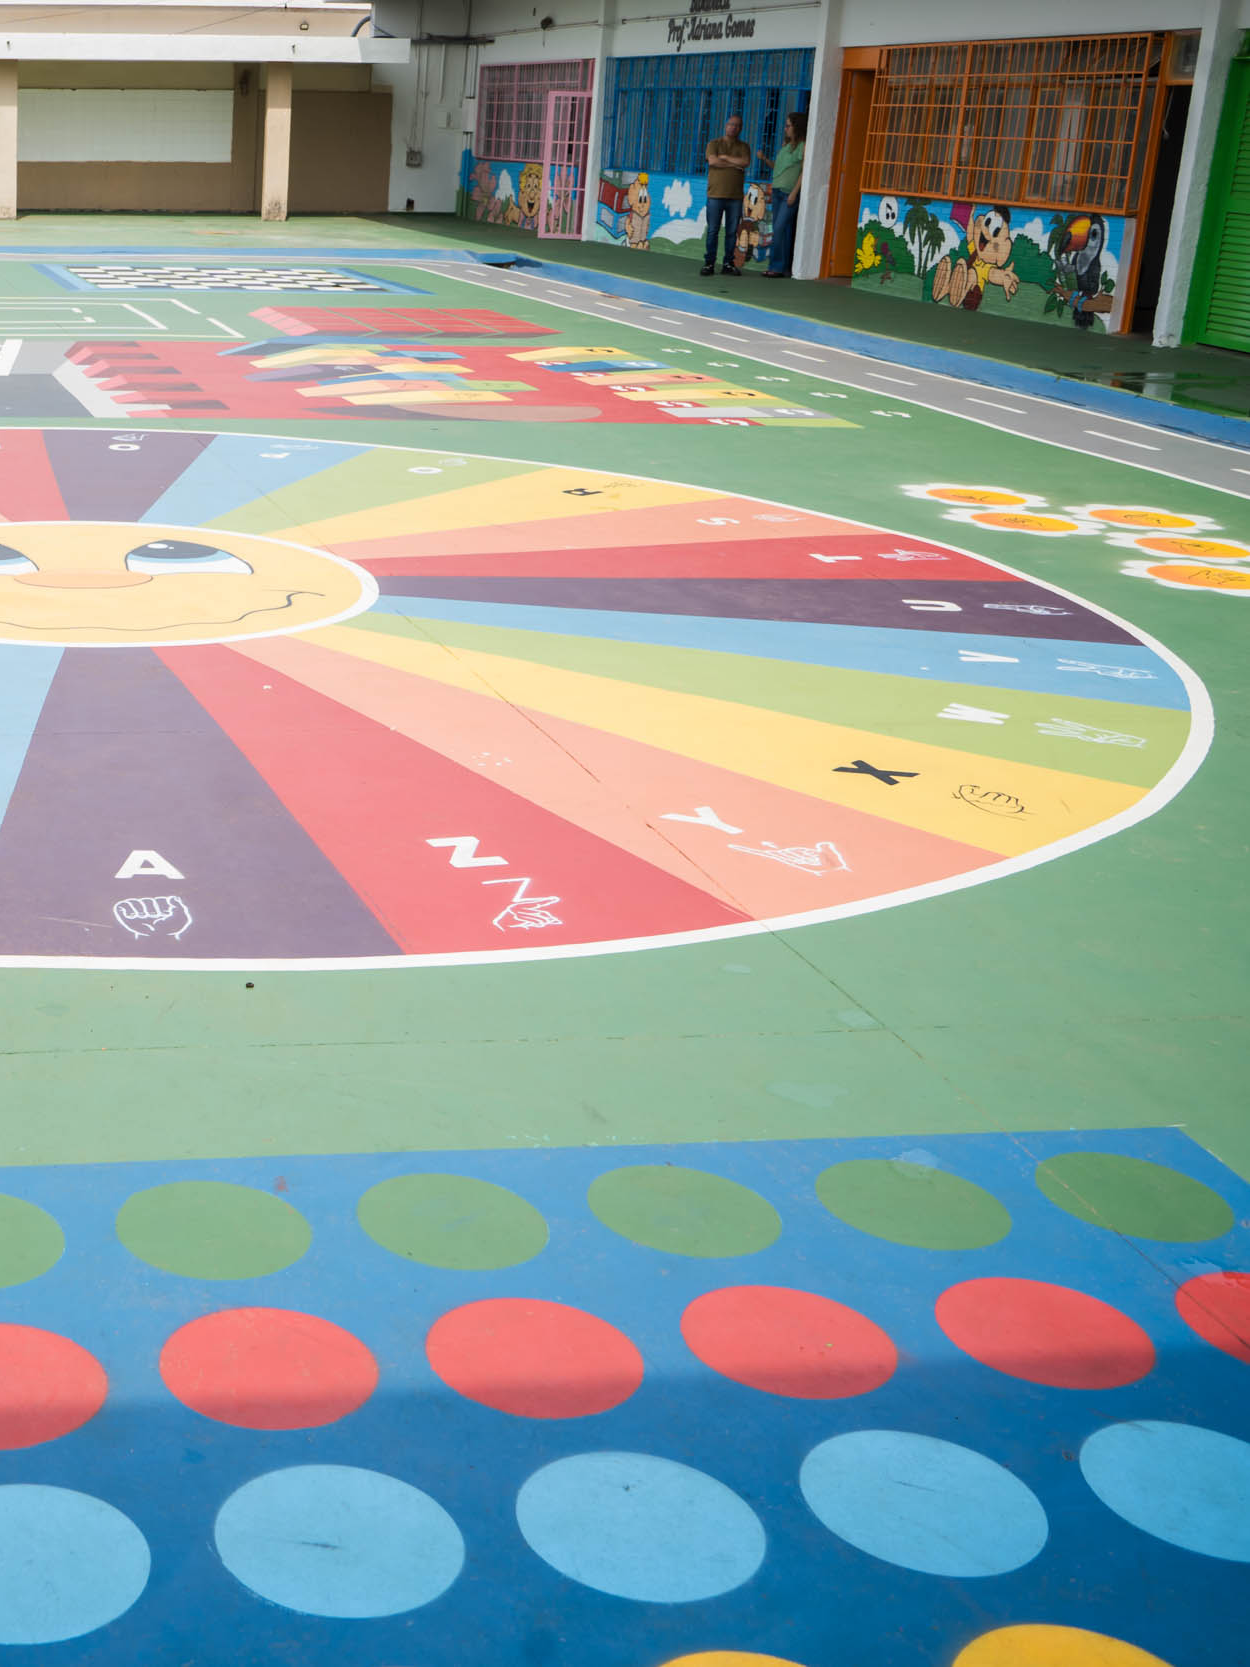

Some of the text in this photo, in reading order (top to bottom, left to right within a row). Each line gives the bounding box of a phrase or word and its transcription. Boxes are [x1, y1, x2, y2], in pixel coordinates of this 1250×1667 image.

[725, 13, 755, 38] Gomes
[108, 443, 141, 451] O
[808, 553, 863, 563] T
[902, 599, 962, 611] U
[957, 650, 1019, 663] V
[936, 702, 1010, 725] W
[832, 759, 920, 786] X
[660, 806, 743, 834] Y
[425, 836, 508, 868] Z
[113, 850, 186, 880] A
